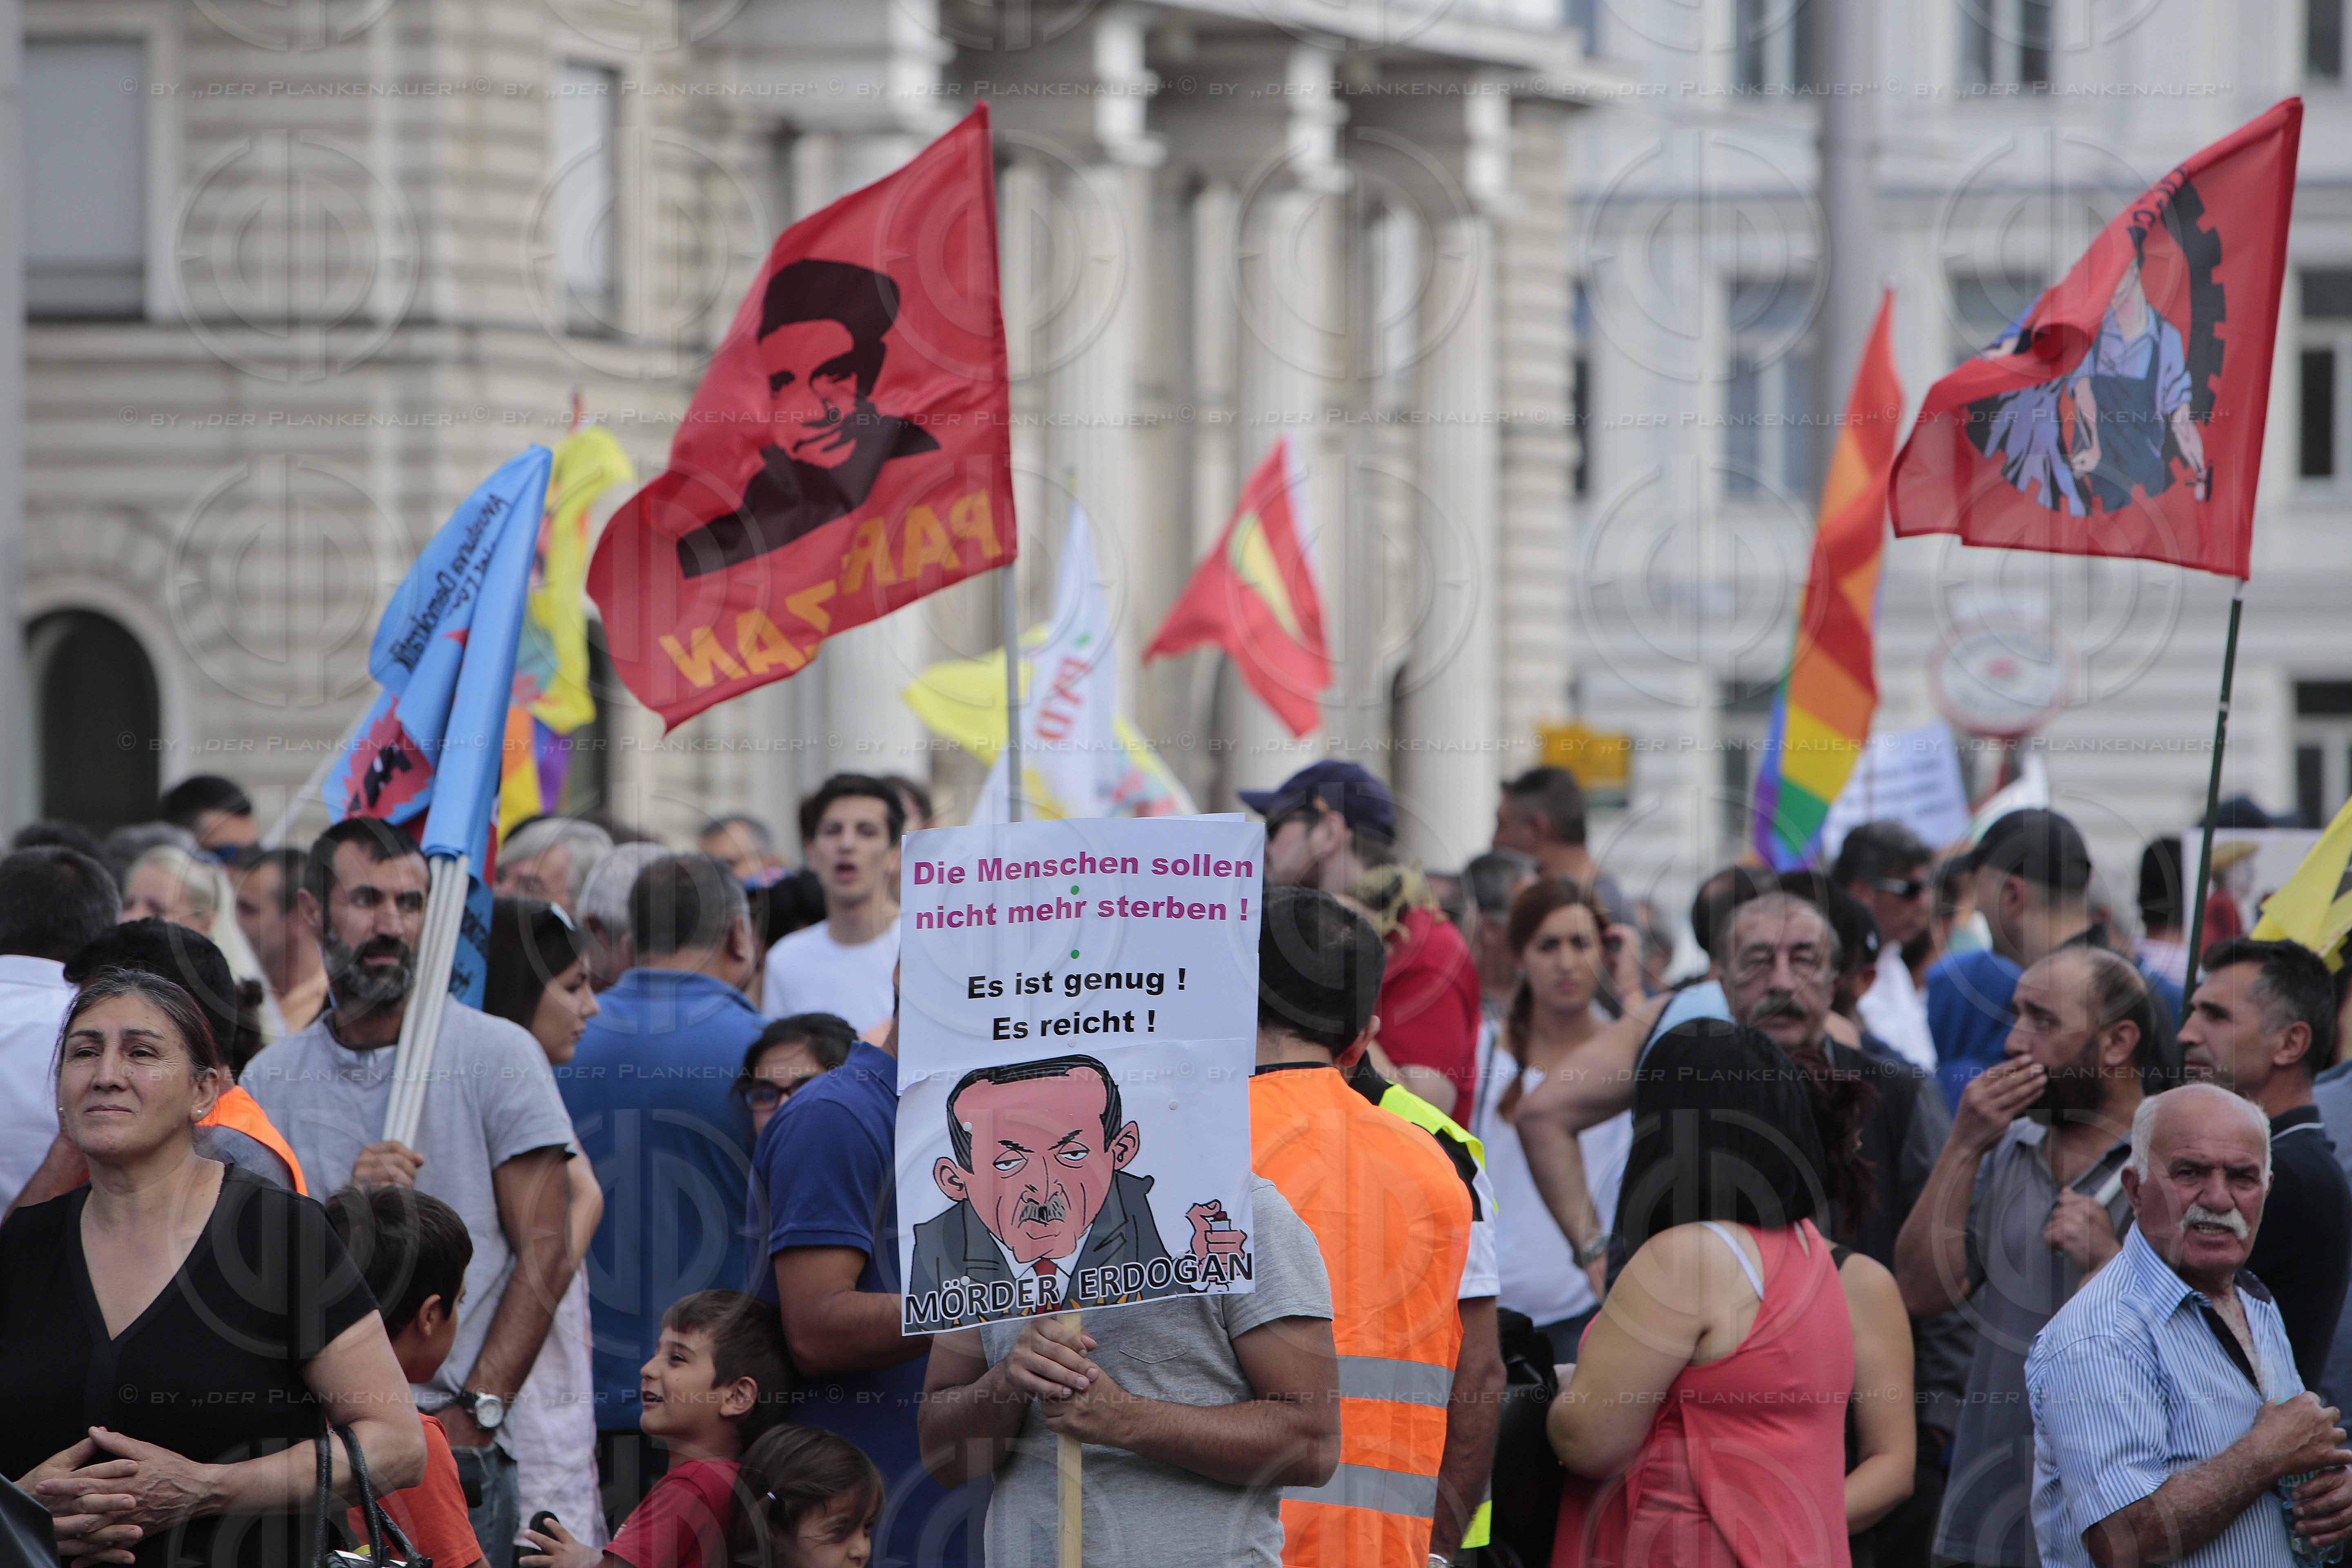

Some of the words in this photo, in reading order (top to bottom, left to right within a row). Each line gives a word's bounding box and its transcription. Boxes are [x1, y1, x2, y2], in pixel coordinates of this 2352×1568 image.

[914, 861, 966, 885] Die
[978, 851, 1138, 882] Menschen
[1151, 853, 1253, 878] sollen
[916, 903, 997, 929] nicht
[1008, 896, 1088, 924] mehr
[1097, 895, 1227, 920] sterben
[1240, 898, 1248, 921] !
[967, 975, 1004, 1000] Es
[1015, 970, 1054, 996] ist
[1064, 972, 1165, 998] genug
[1177, 967, 1187, 991] !
[992, 1016, 1029, 1041] Es
[1040, 1009, 1135, 1037] reicht
[1147, 1009, 1156, 1033] !
[904, 1274, 1060, 1325] MÖRDER
[1078, 1252, 1254, 1300] ERDOGAN
